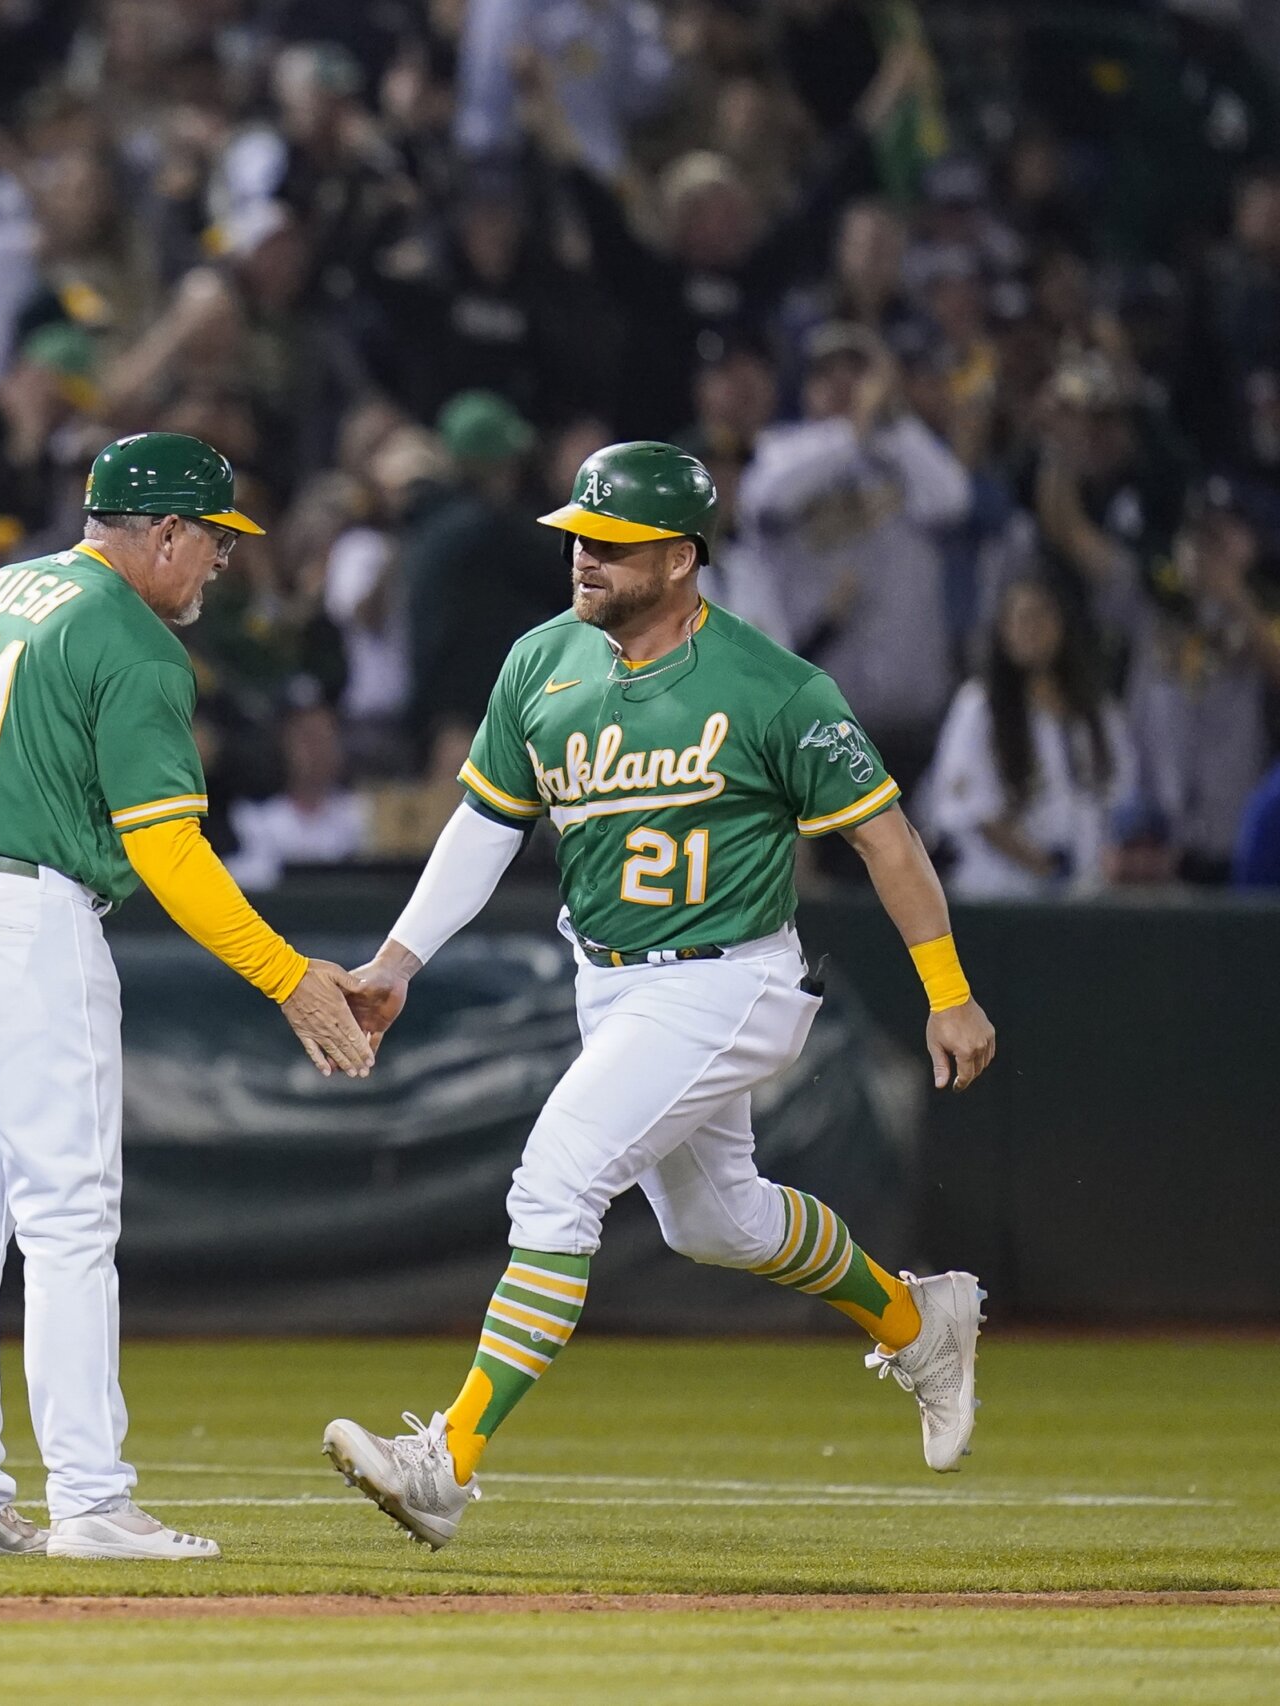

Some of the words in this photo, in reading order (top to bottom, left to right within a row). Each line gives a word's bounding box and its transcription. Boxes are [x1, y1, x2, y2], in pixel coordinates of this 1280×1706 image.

[578, 470, 613, 507] A's
[525, 711, 729, 804] akland
[620, 825, 709, 906] 21
